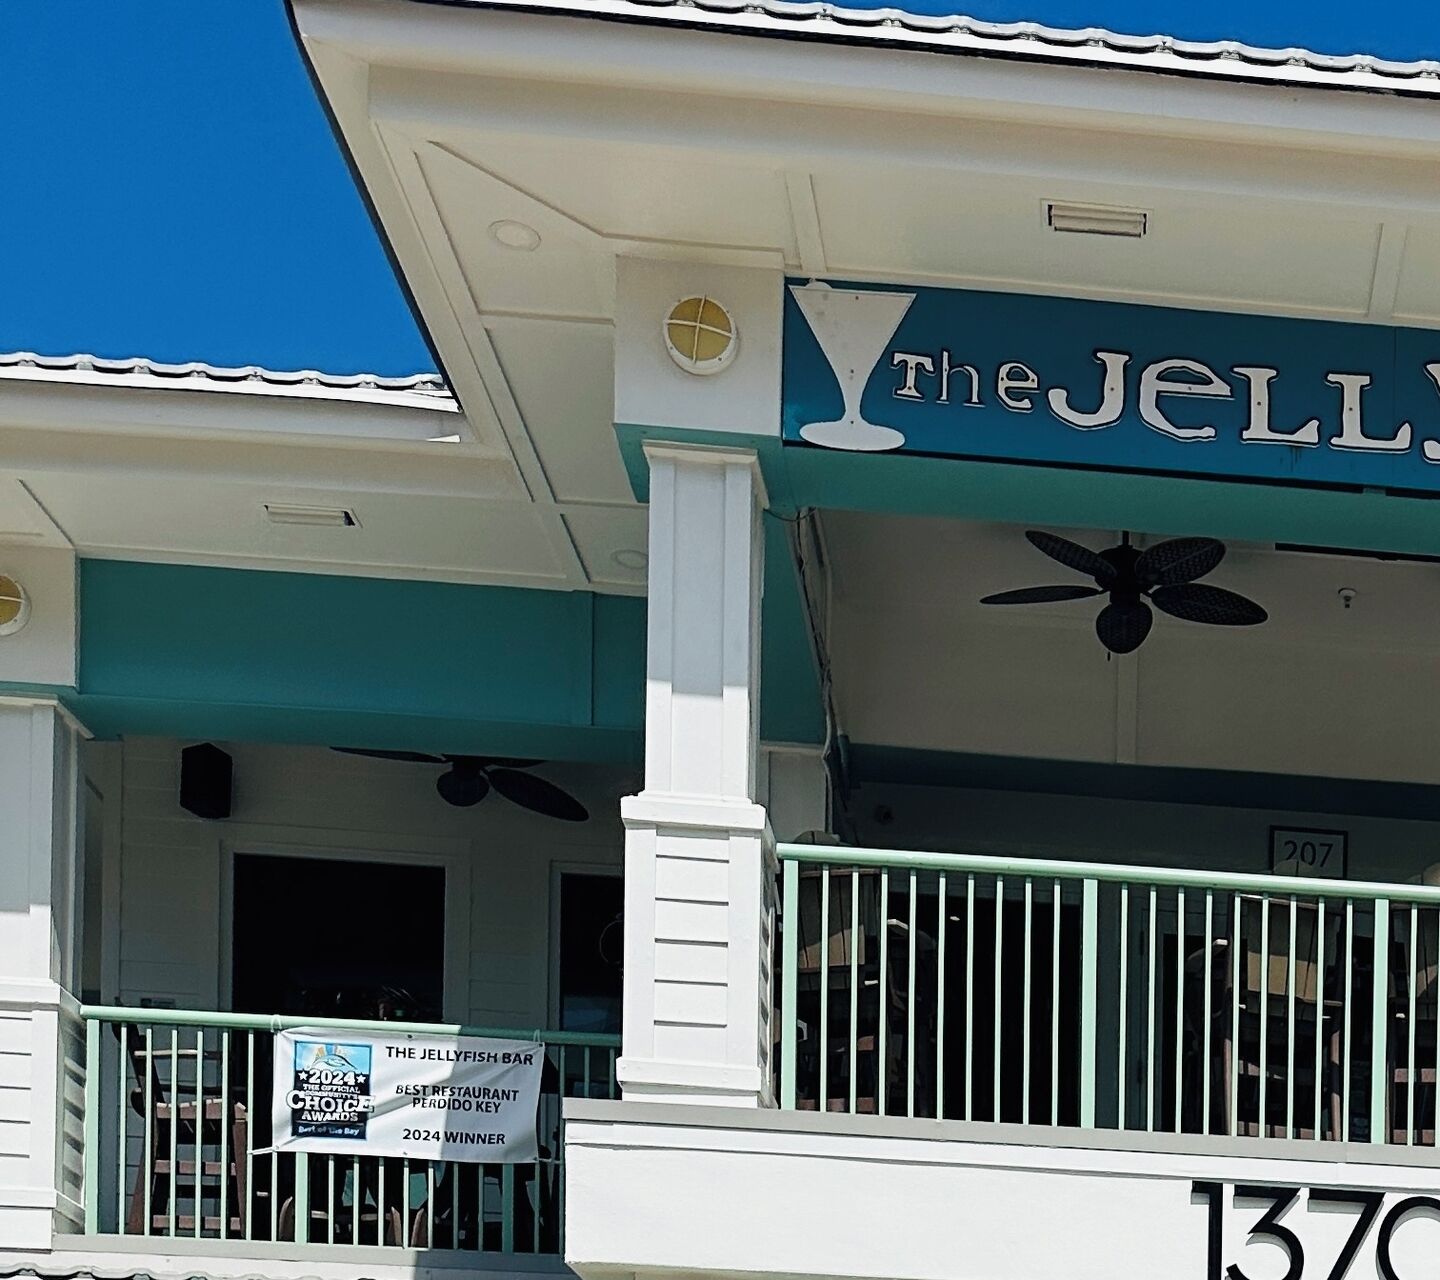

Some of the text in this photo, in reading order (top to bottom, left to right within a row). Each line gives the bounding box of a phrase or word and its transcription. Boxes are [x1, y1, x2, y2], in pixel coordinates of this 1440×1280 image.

[890, 350, 1040, 412] The
[1285, 840, 1334, 867] 207
[386, 1046, 534, 1066] THE JELLYFISH BAR
[308, 1069, 356, 1086] 2024
[303, 1083, 361, 1094] THE OFFICIAL
[395, 1085, 519, 1102] BEST RESTAURANT
[286, 1089, 376, 1113] CHOICE
[412, 1097, 502, 1114] PERDIDO KEY
[301, 1110, 359, 1122] AWARDS
[344, 1127, 360, 1136] Bay
[403, 1129, 506, 1145] 2024 WINNER
